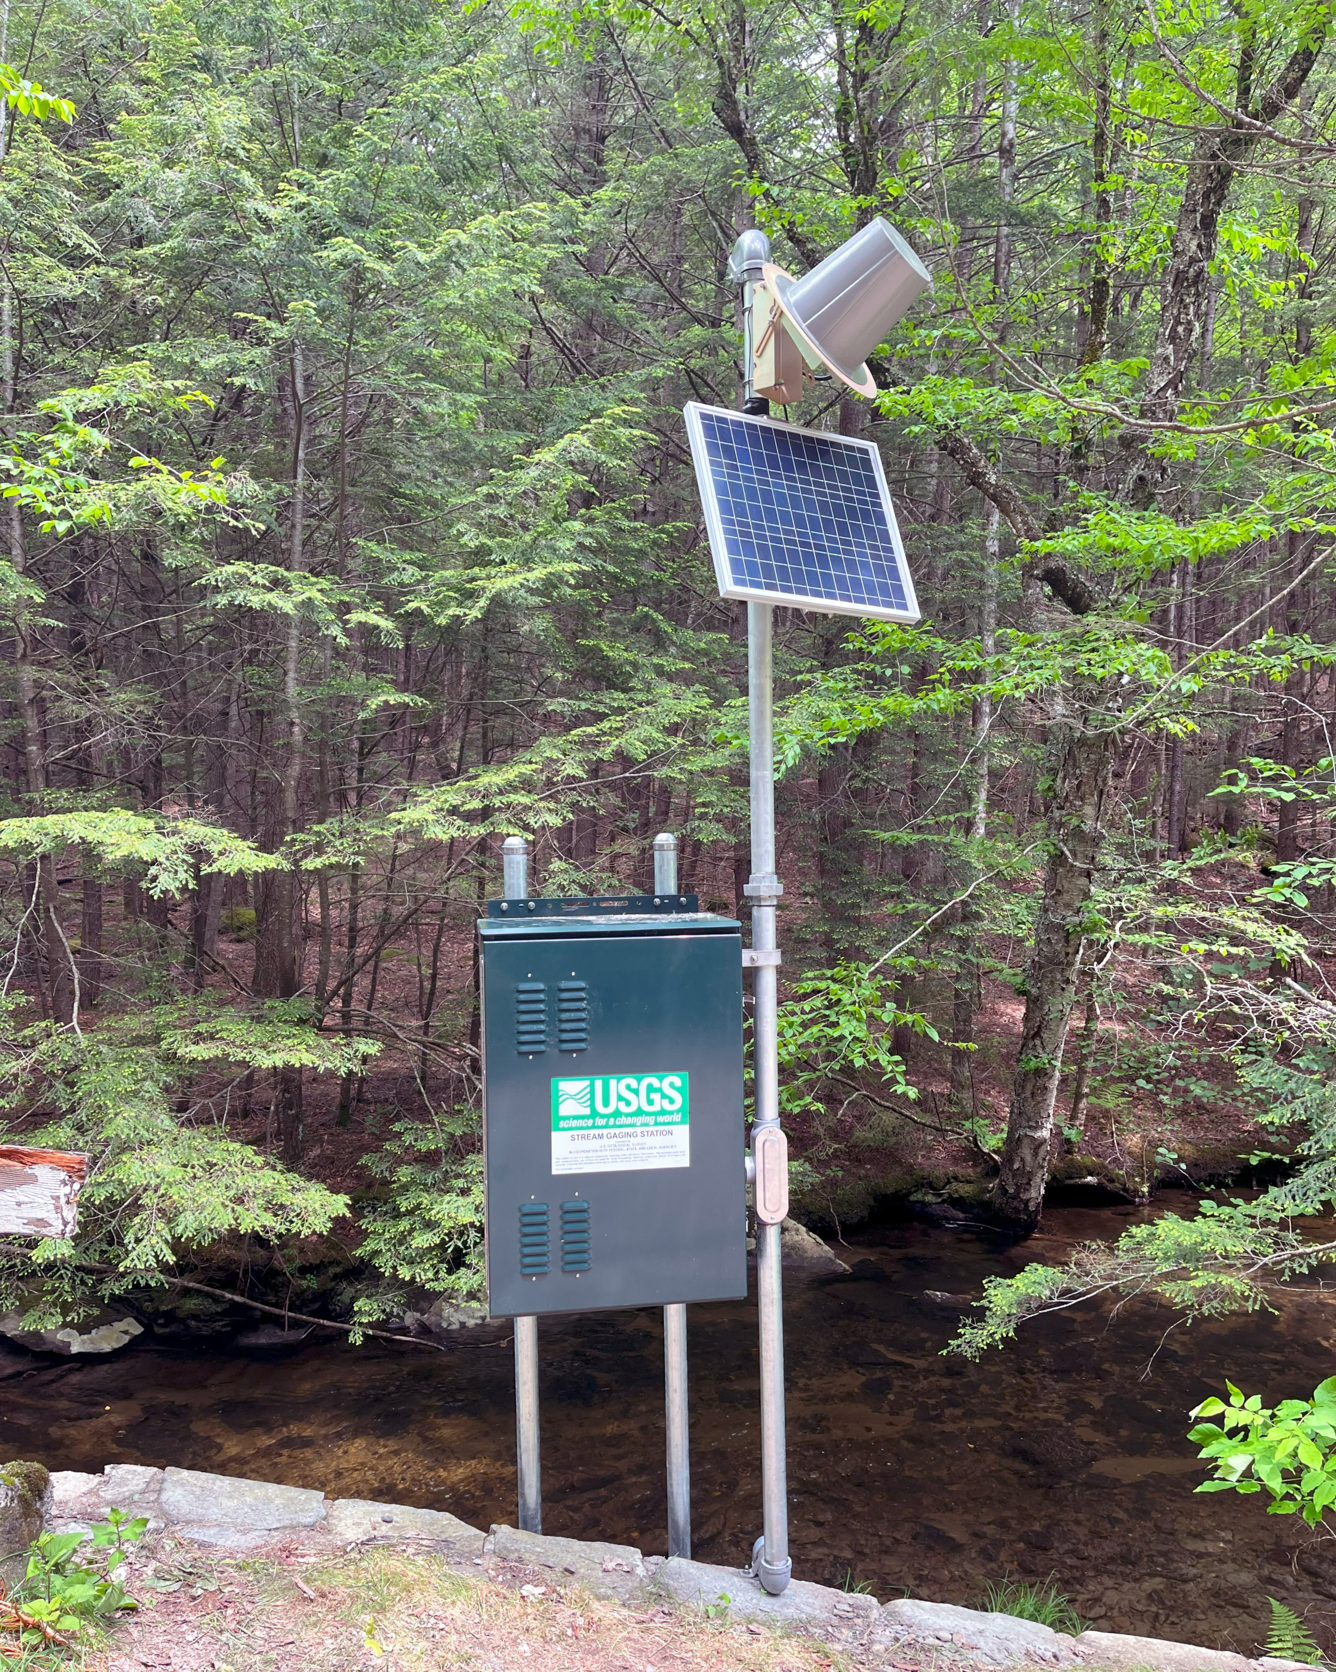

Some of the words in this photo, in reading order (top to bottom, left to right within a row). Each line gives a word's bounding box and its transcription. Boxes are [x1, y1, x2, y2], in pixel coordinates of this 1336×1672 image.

[594, 1075, 682, 1114] USGS
[558, 1117, 593, 1128] science
[594, 1116, 607, 1127] for
[615, 1114, 655, 1126] changing
[656, 1112, 682, 1123] world
[570, 1132, 604, 1141] STREAM
[606, 1131, 638, 1140] GAGING
[640, 1129, 673, 1138] STATION
